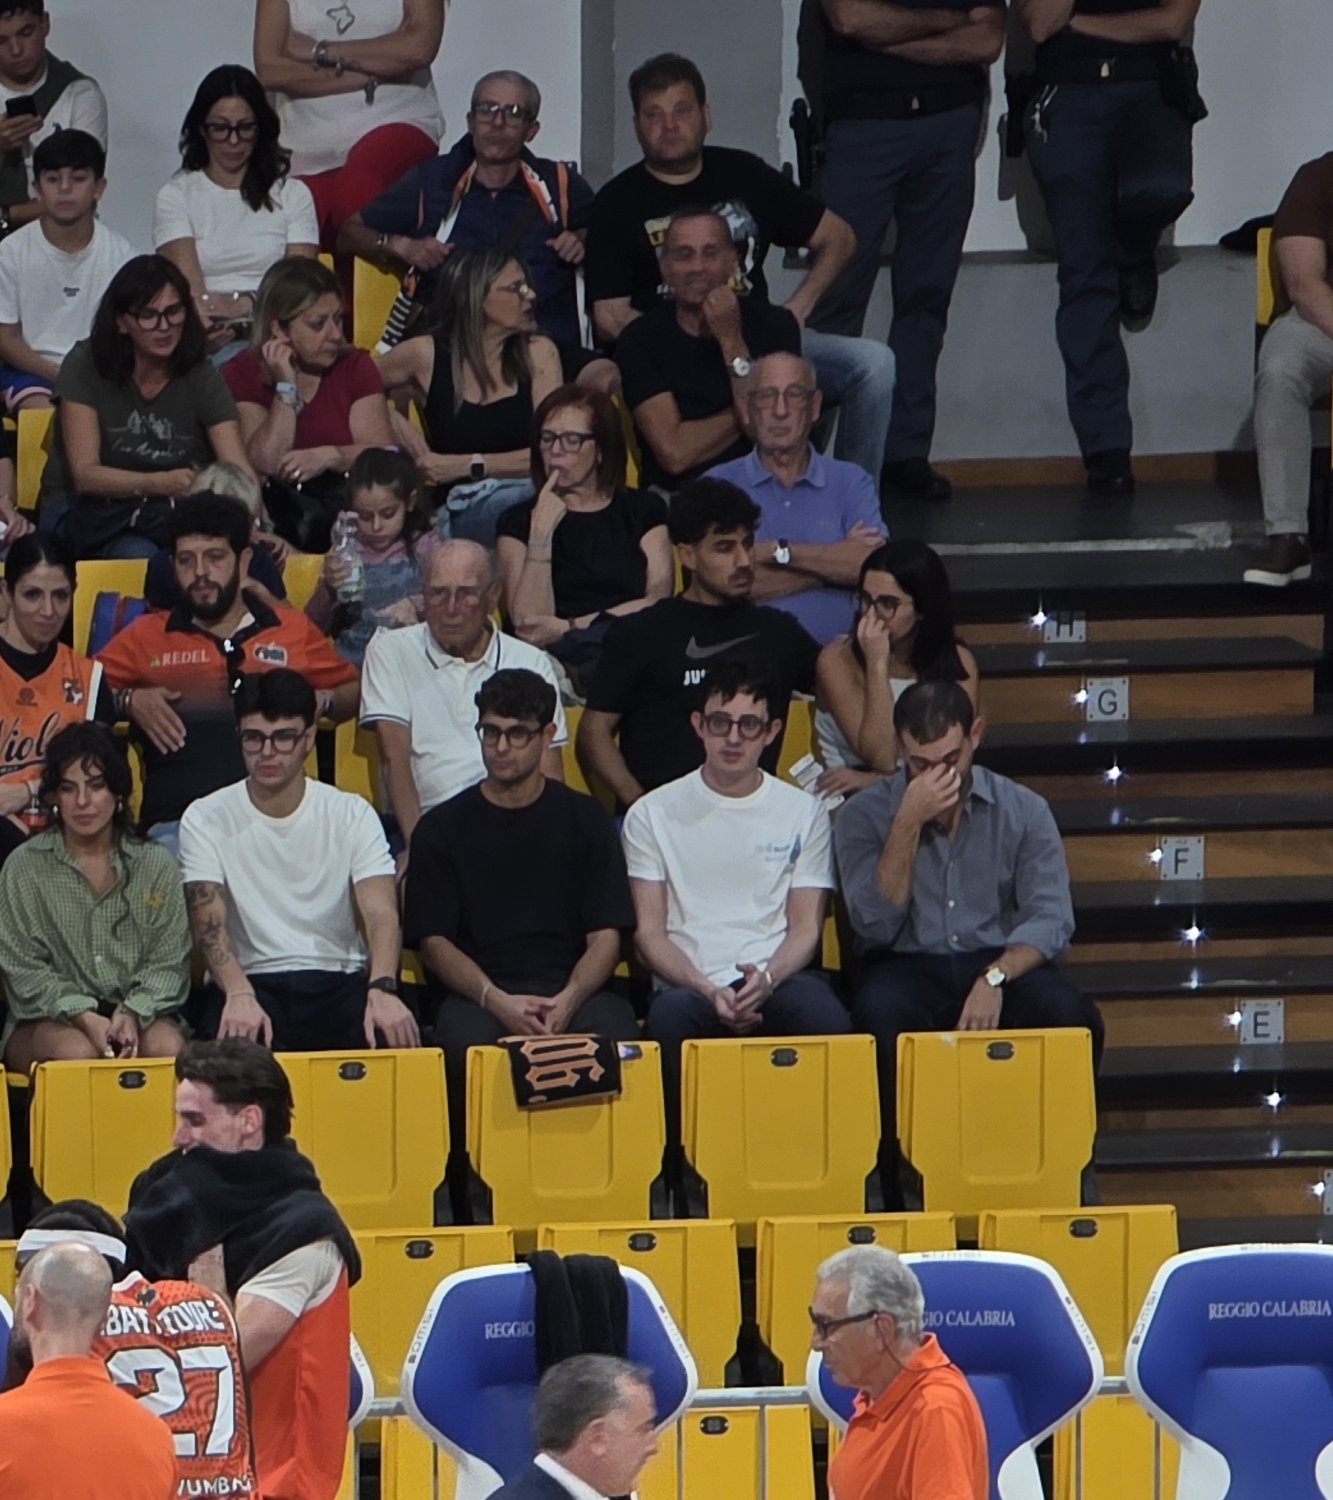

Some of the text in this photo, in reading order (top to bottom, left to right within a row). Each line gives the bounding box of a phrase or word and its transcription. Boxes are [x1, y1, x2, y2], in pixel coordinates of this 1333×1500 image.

[162, 649, 210, 666] REDEL
[1097, 689, 1118, 716] G
[1174, 848, 1190, 875] F
[1253, 1011, 1271, 1038] E
[945, 1309, 1016, 1327] CALABRIA
[1208, 1299, 1332, 1320] REGGIO CALABRIA
[484, 1320, 536, 1340] REGGIO
[104, 1344, 235, 1457] 27
